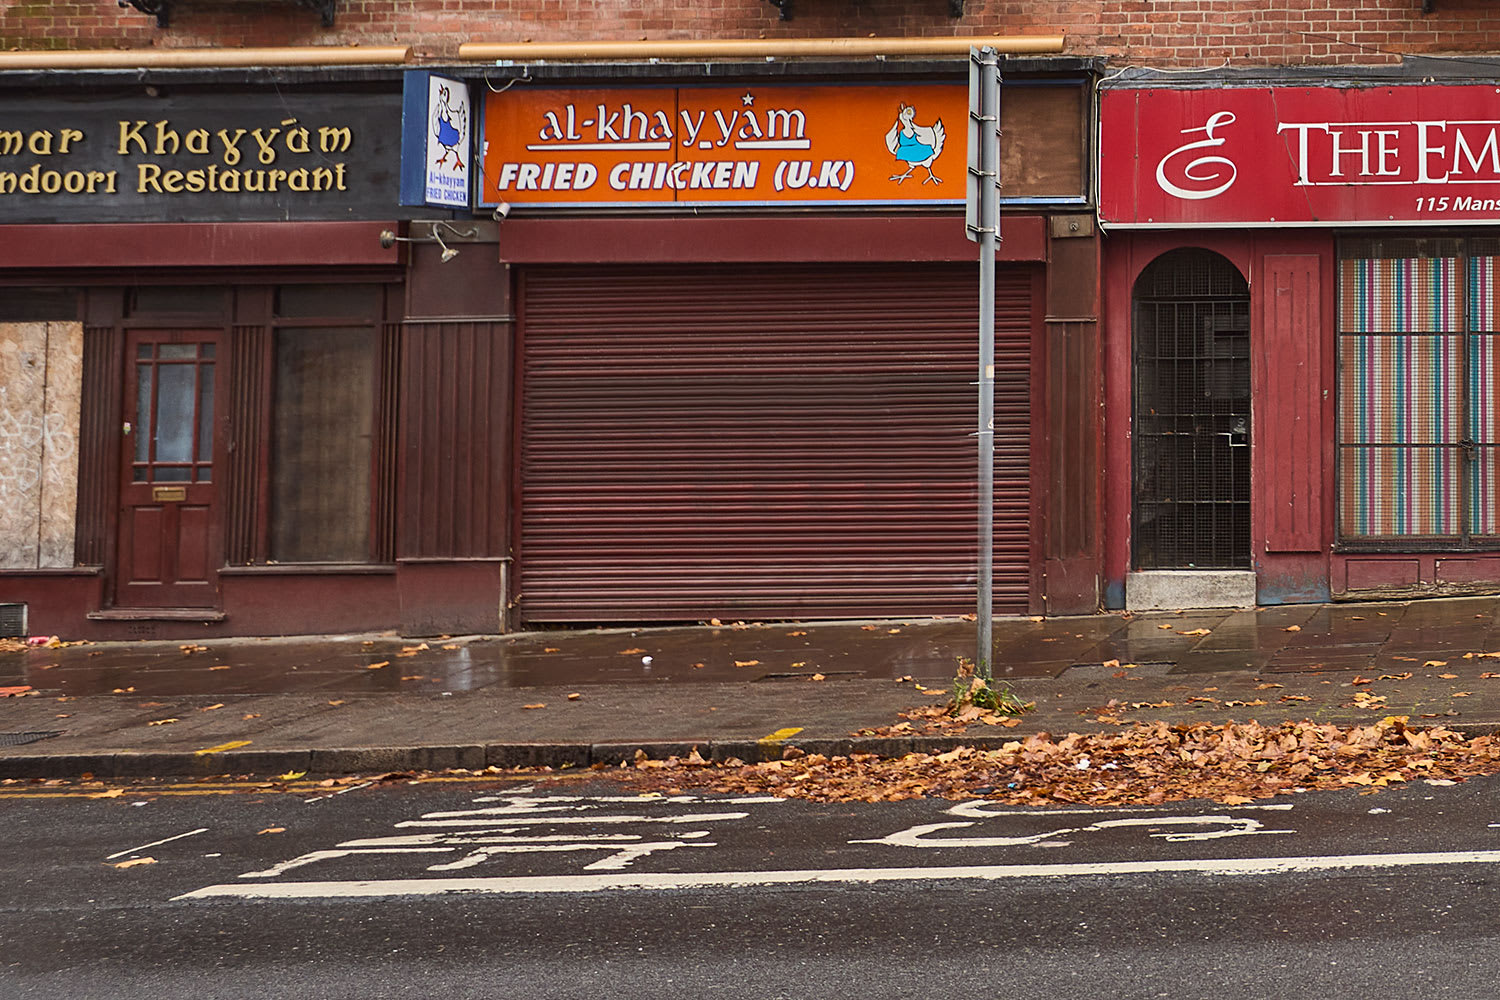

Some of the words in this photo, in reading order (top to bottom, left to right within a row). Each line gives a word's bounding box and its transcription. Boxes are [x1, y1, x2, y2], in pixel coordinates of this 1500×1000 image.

[1277, 122, 1401, 186] THE
[138, 163, 347, 193] Restaurant
[499, 162, 598, 191] FRIED
[608, 161, 760, 191] CHICKEN
[773, 160, 855, 192] (U.K)
[426, 187, 442, 200] FRIED
[444, 188, 467, 202] CHICKEN
[1416, 197, 1449, 211] 115
